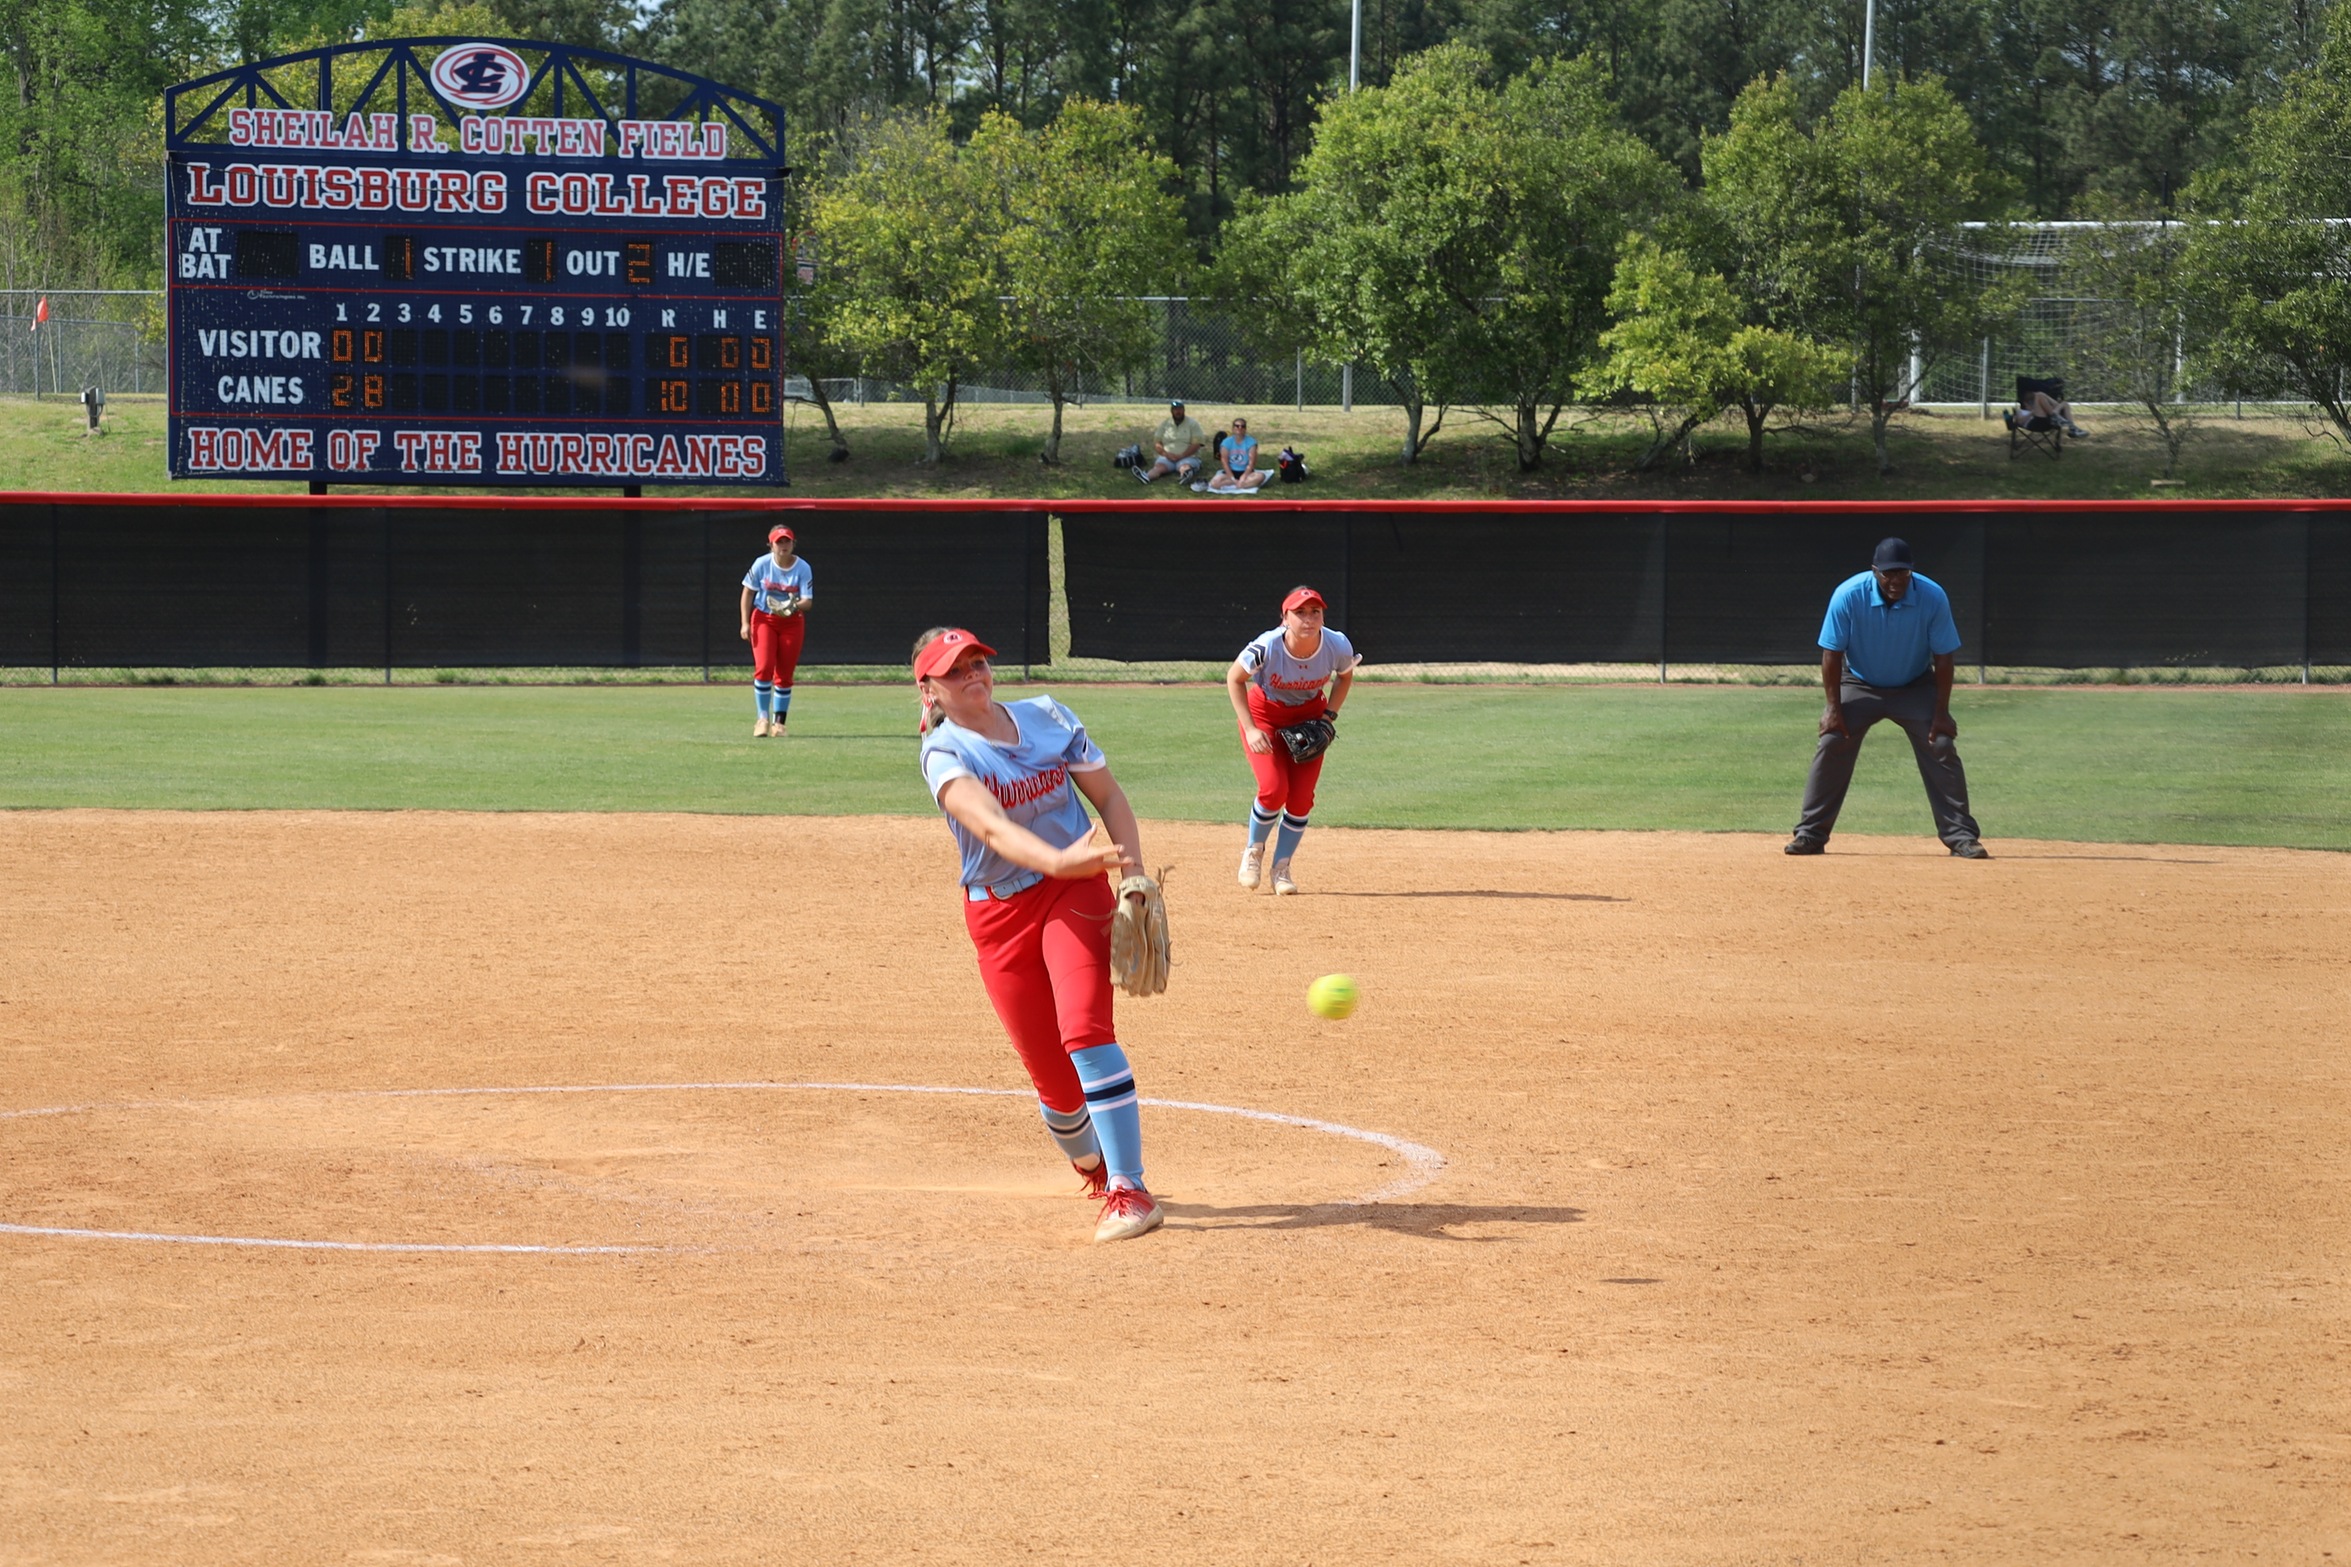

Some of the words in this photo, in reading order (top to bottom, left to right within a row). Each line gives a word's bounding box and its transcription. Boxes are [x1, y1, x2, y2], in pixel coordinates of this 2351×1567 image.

[229, 108, 399, 152] SHEILAH
[410, 114, 449, 153] R.
[461, 115, 607, 157] COTTEN
[618, 120, 727, 160] FIELD
[187, 162, 507, 214] LOUISBURG
[526, 172, 766, 219] COLLEGE
[188, 227, 222, 253] AT
[179, 253, 231, 279] BAT
[309, 243, 380, 271] BALL
[423, 247, 522, 274] STRIKE
[566, 250, 620, 276] OUT
[628, 243, 651, 283] 2
[667, 252, 711, 278] H/E
[336, 303, 348, 322] 1
[367, 303, 381, 322] 2
[397, 304, 412, 323] 3
[427, 304, 442, 323] 4
[459, 305, 473, 324] 5
[488, 306, 503, 325] 6
[520, 306, 533, 325] 7
[550, 307, 565, 326] 8
[581, 307, 595, 326] 9
[605, 307, 631, 327] 10
[661, 309, 676, 328] R
[713, 310, 727, 329] H
[754, 310, 767, 330] E
[199, 329, 321, 359] VISITOR
[333, 330, 352, 362] 0
[364, 331, 383, 362] 0
[218, 376, 304, 405] CANES
[333, 375, 352, 407] 2
[188, 427, 313, 471] HOME
[327, 430, 380, 472] OF
[394, 430, 482, 474] THE
[496, 432, 766, 477] HURRICANES
